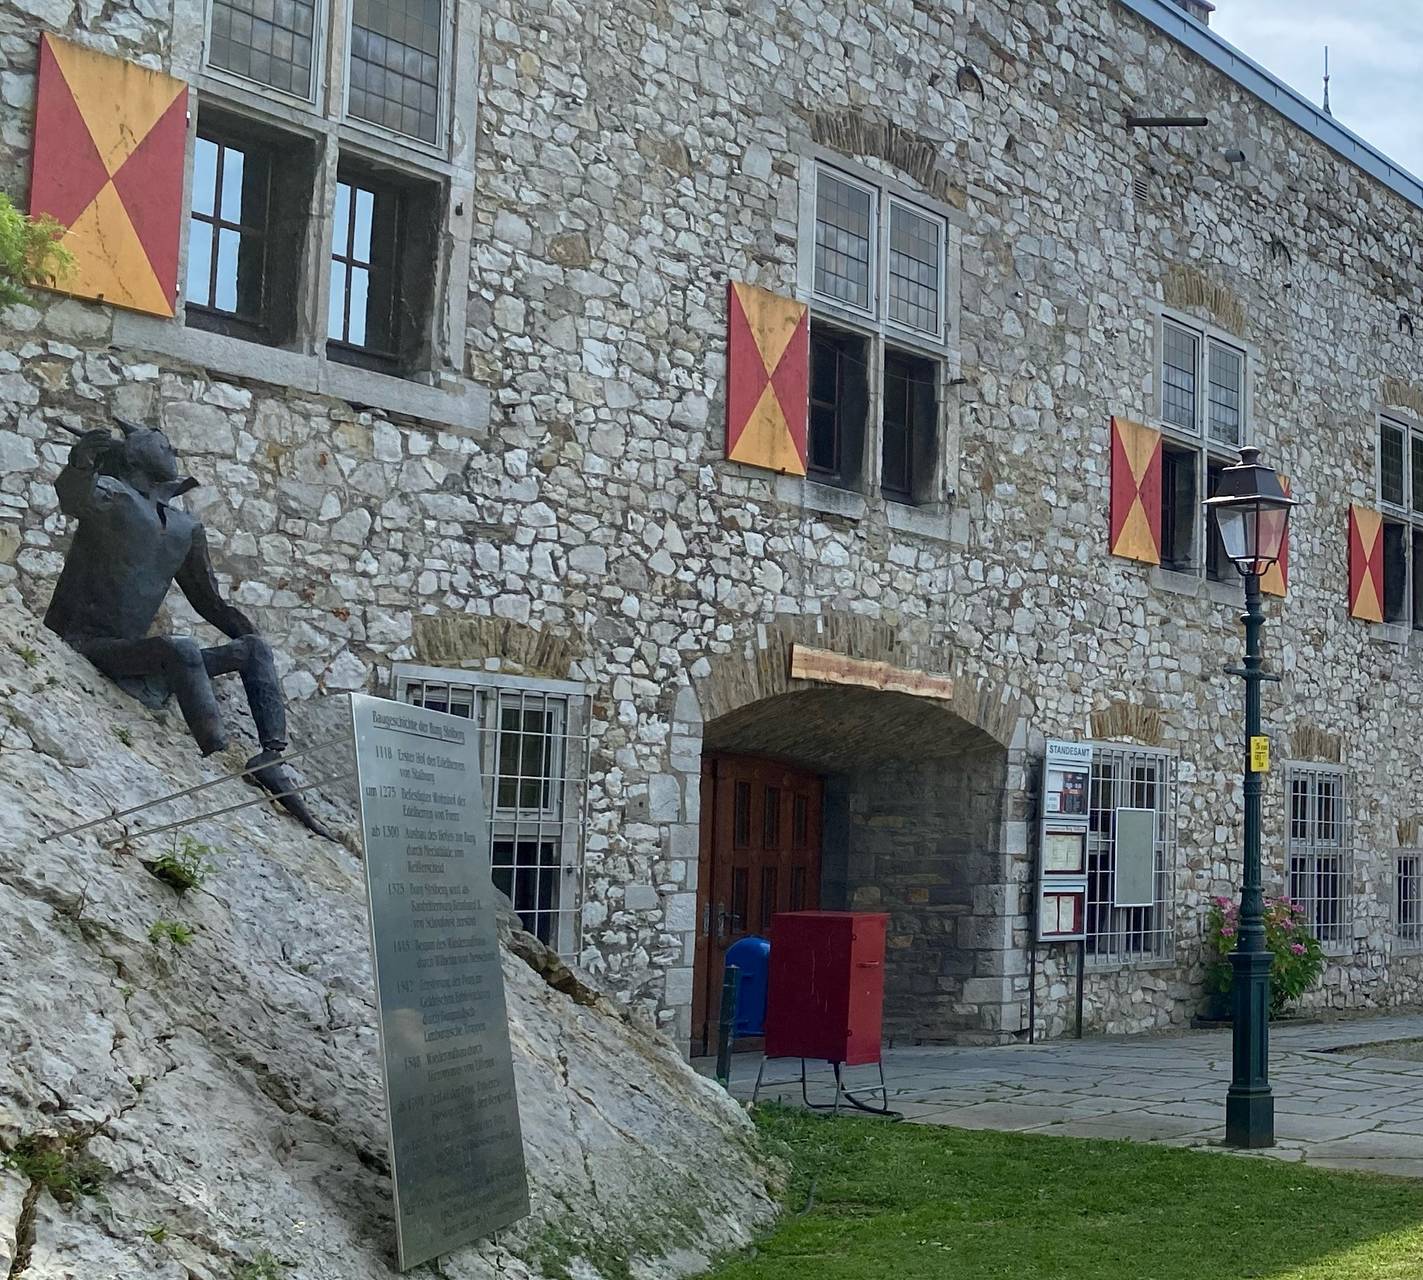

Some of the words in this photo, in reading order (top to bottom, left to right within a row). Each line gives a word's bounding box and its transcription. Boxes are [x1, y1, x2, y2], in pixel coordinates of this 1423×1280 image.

[376, 745, 392, 759] 1118
[1049, 744, 1090, 757] STANDESAMT
[366, 786, 377, 796] um
[380, 785, 396, 797] 1275
